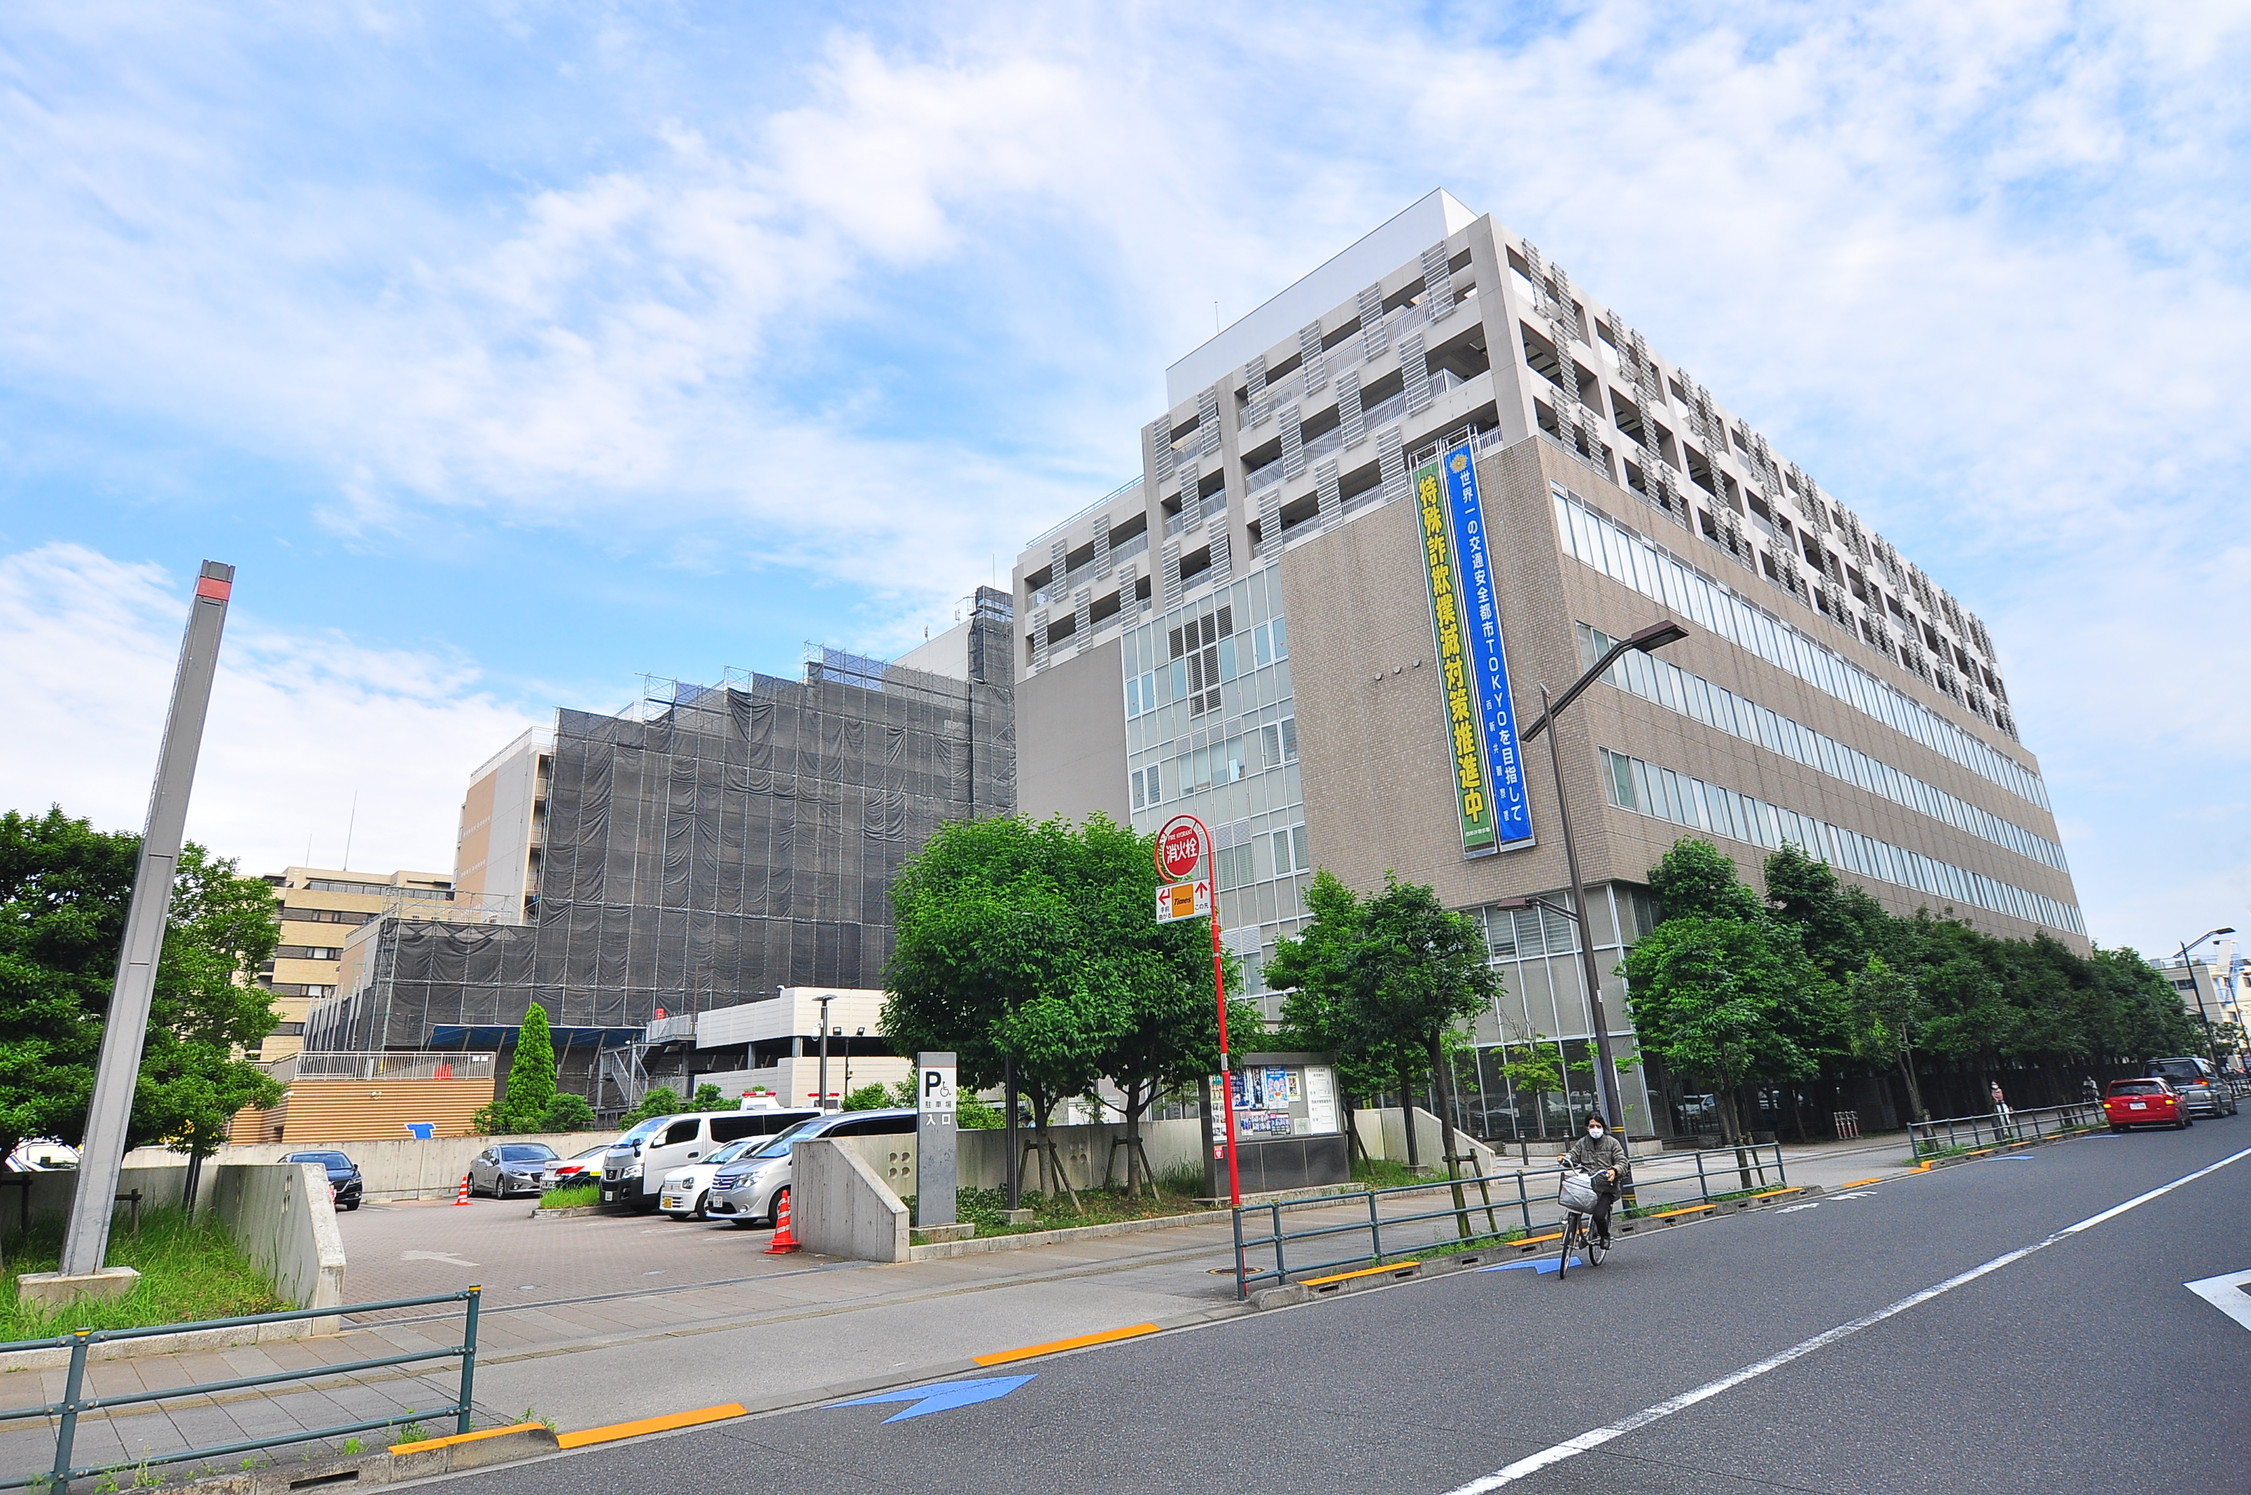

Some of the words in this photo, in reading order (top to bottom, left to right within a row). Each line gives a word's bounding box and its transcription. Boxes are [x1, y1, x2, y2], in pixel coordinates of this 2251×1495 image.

[1418, 474, 1485, 823] 特殊詐欺撲滅対策推進中
[1459, 471, 1522, 822] 世界一の交通安全都市TOKYOを目指して
[1166, 838, 1198, 865] 消火栓
[1173, 897, 1191, 906] Times
[926, 1072, 941, 1097] P
[926, 1114, 951, 1126] 入口
